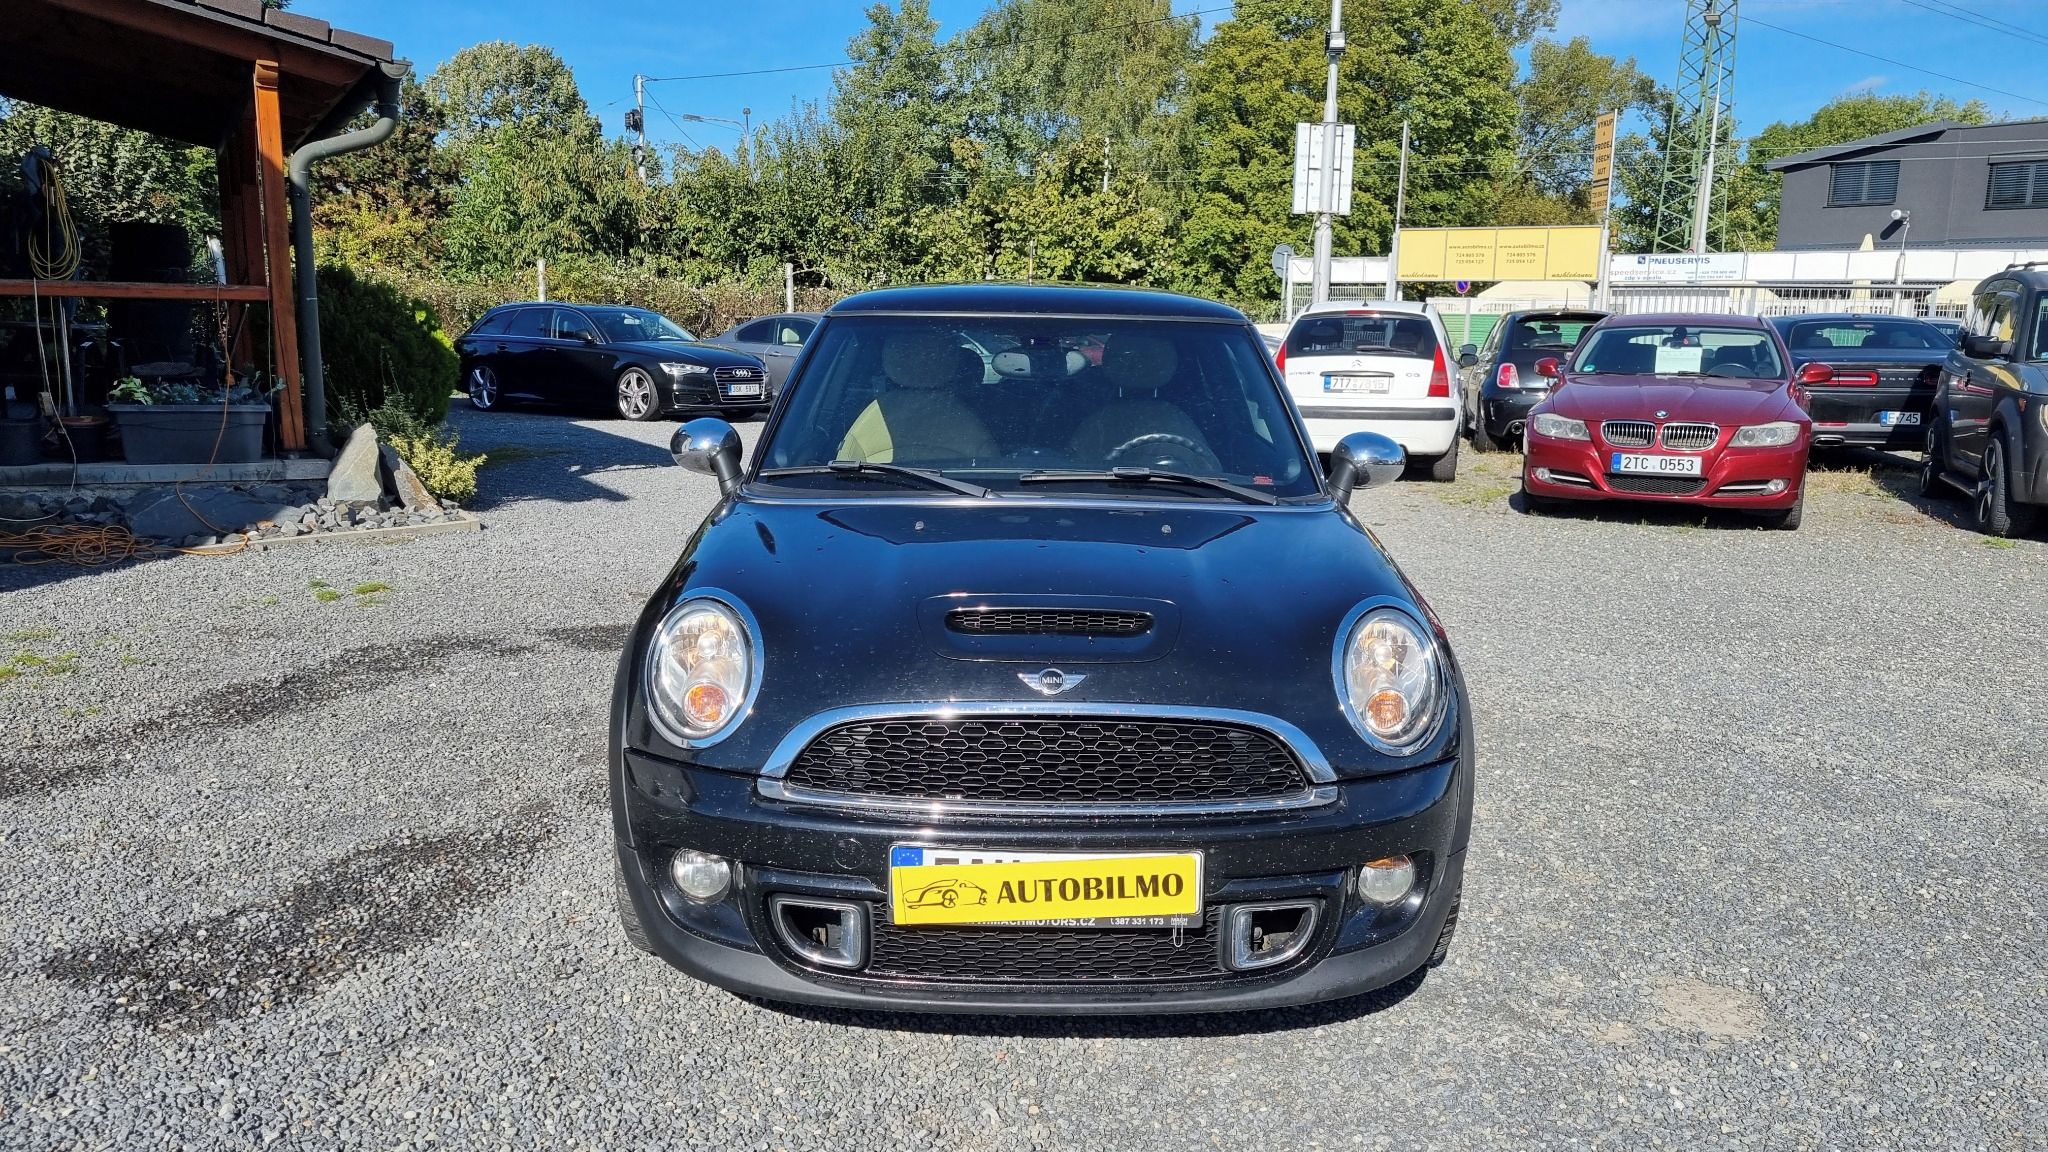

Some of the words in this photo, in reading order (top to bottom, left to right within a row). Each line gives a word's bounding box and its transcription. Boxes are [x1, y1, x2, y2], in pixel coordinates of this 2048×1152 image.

[1648, 257, 1711, 265] PNEUSERVIS
[1899, 413, 1919, 424] 745
[1624, 456, 1649, 470] 2TC
[1660, 458, 1694, 471] 0553
[1042, 676, 1063, 684] MINI
[997, 872, 1184, 905] AUTOBILMO
